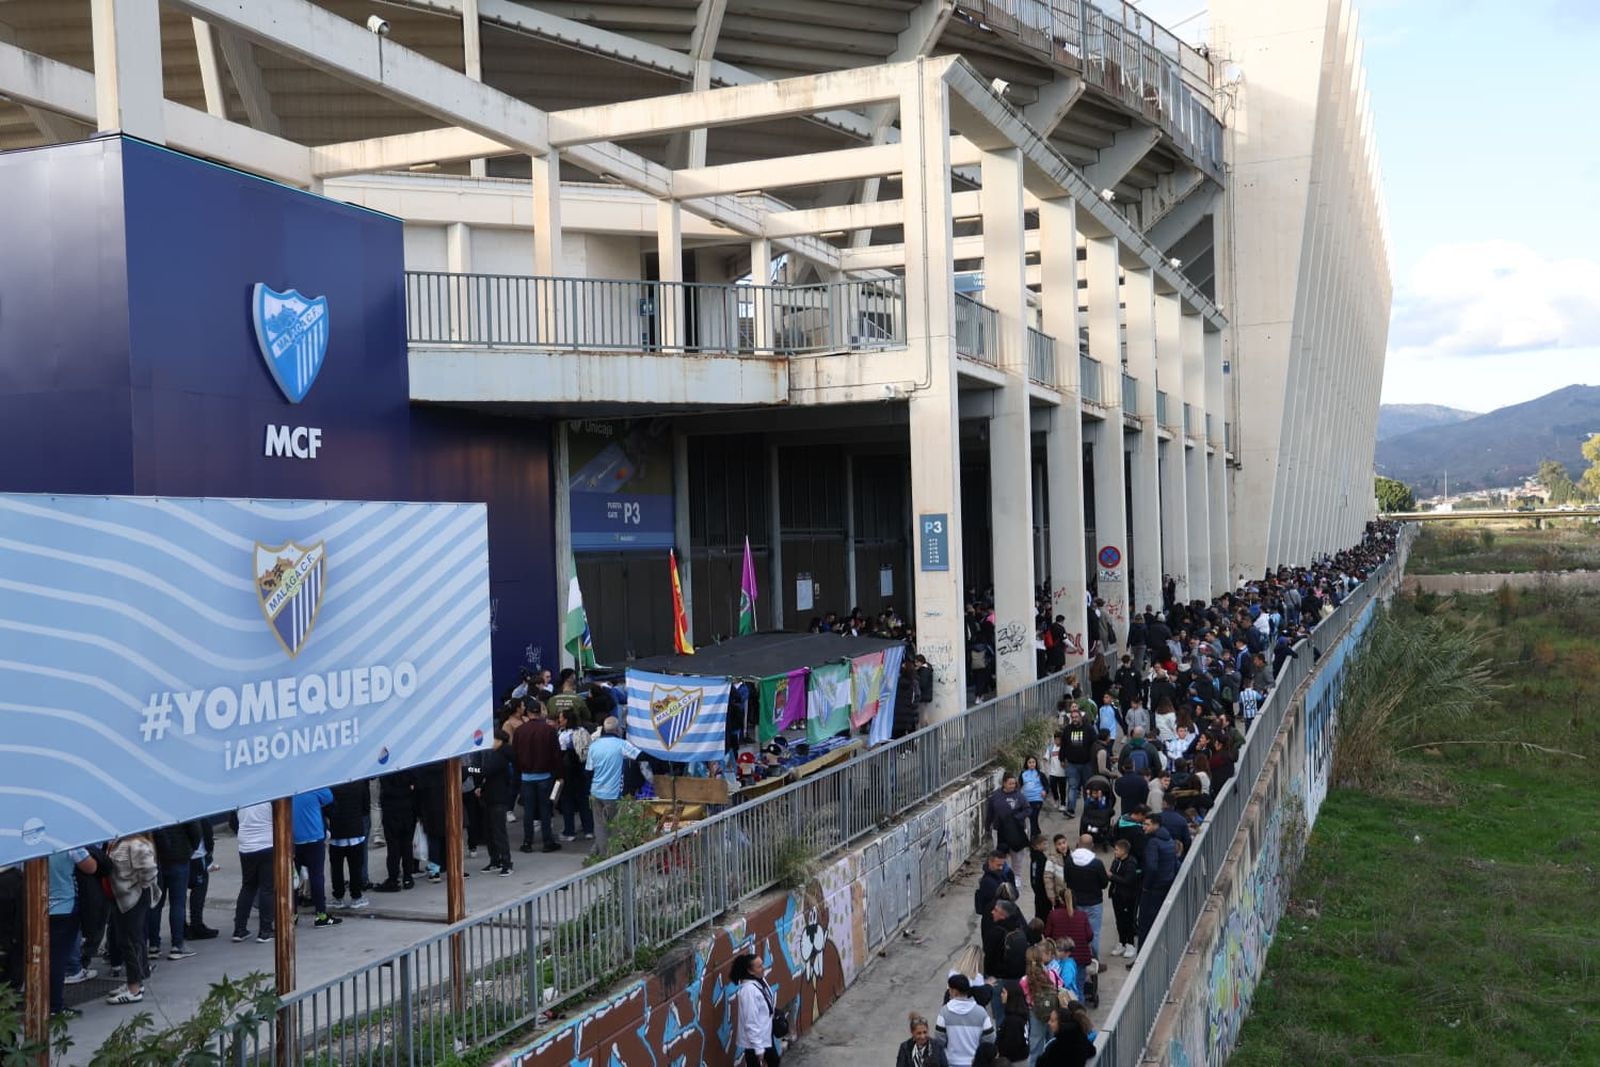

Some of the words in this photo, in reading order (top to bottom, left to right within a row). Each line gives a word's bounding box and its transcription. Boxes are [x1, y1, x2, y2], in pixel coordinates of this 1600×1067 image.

[265, 424, 322, 459] MCF
[624, 502, 641, 525] P3
[924, 521, 943, 534] P3
[138, 661, 418, 742] #YOMEQUEDO
[224, 717, 360, 771] ¡ABÓNATE!
